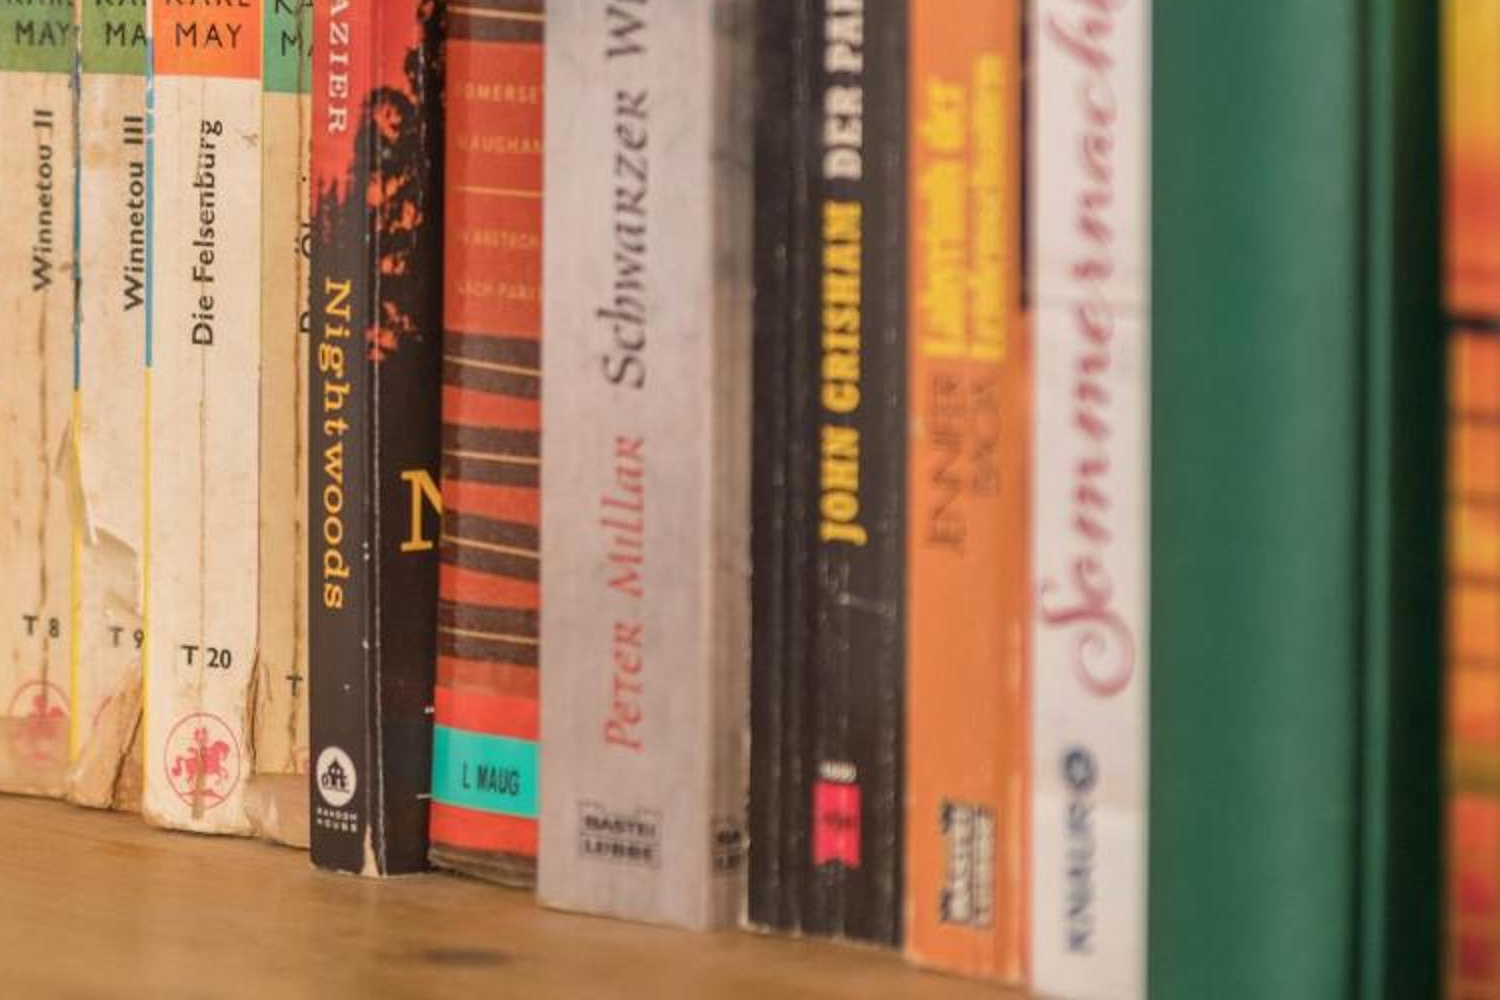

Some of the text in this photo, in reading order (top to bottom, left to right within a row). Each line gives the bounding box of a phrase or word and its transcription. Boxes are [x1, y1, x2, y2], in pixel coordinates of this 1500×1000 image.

[15, 19, 71, 48] MAY
[105, 22, 147, 47] MA
[175, 22, 243, 49] MAY
[824, 89, 864, 180] DER
[32, 109, 54, 291] Winnetou II
[123, 114, 145, 311] Winnetou III
[191, 119, 223, 347] Die Felsenburg
[822, 202, 863, 413] GRISHAM
[318, 276, 353, 611] Nightwoods
[820, 425, 866, 545] JOHN
[23, 614, 61, 639] T 8
[108, 625, 145, 649] T 9
[181, 643, 232, 670] T 20
[462, 760, 521, 797] L MAUG
[316, 806, 358, 820] RANDOM
[316, 817, 358, 831] HOUSE
